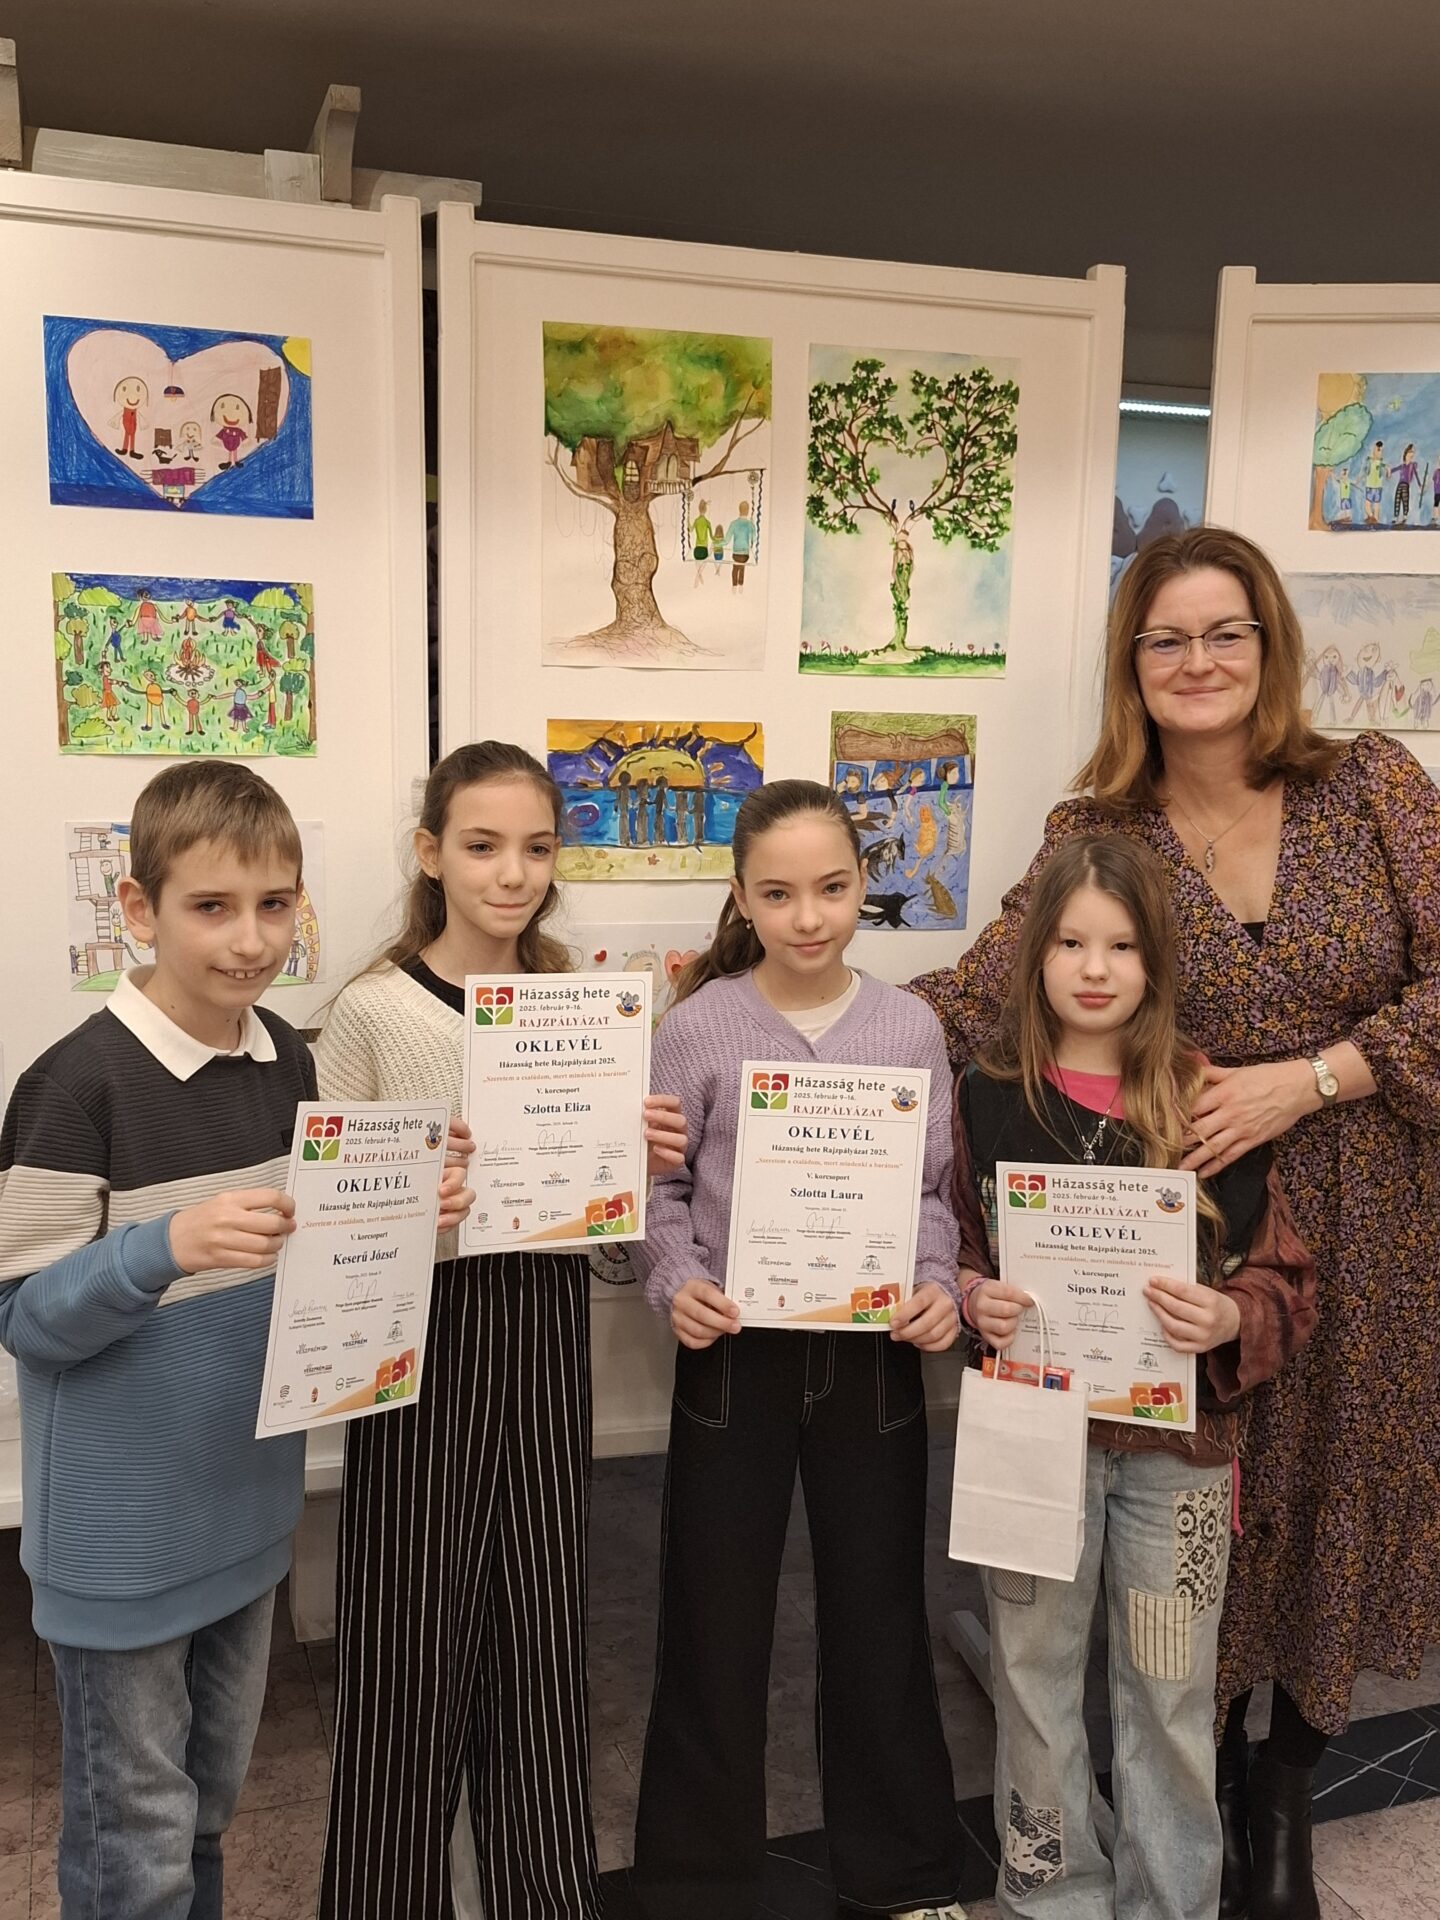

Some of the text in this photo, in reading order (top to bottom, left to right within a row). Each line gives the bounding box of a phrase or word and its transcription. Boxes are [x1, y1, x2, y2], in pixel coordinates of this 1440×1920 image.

[519, 987, 610, 1001] Házasság hete
[519, 1016, 610, 1028] RAJZPÁLYÁZAT
[515, 1036, 602, 1053] OKLEVÉL
[499, 1061, 533, 1069] Házasság
[551, 1058, 597, 1068] Rajzpályázat
[599, 1057, 617, 1065] 2025.
[545, 1086, 580, 1094] korcsoport
[795, 1077, 886, 1092] Házasság hete
[814, 1092, 838, 1100] február
[523, 1102, 591, 1115] Szlotta Eliza
[793, 1104, 884, 1117] RAJZPÁLYÁZAT
[347, 1117, 423, 1134] Házasság hete
[788, 1125, 875, 1141] OKLEVÉL
[772, 1144, 804, 1153] Házasság
[822, 1146, 868, 1156] Rajzpályázat
[870, 1148, 888, 1156] 2025.
[343, 1150, 420, 1164] RAJZPÁLYÁZAT
[336, 1172, 411, 1193] OKLEVÉL
[815, 1173, 850, 1181] korcsoport
[1052, 1178, 1149, 1193] Házasság hete
[790, 1187, 863, 1200] Szlotta Laura
[319, 1196, 419, 1211] Házasság hete Rajzpályázat 2025.
[1053, 1205, 1150, 1218] RAJZPÁLYÁZAT
[357, 1231, 388, 1241] korcsoport
[1050, 1224, 1142, 1241] OKLEVÉL
[1035, 1241, 1069, 1251] Házasság
[1088, 1244, 1136, 1255] Rajzpályázat
[1138, 1247, 1158, 1256] 2025.
[332, 1247, 399, 1266] Keserű József
[1082, 1270, 1119, 1278] korcsoport
[1067, 1283, 1126, 1296] Sipos Rozi
